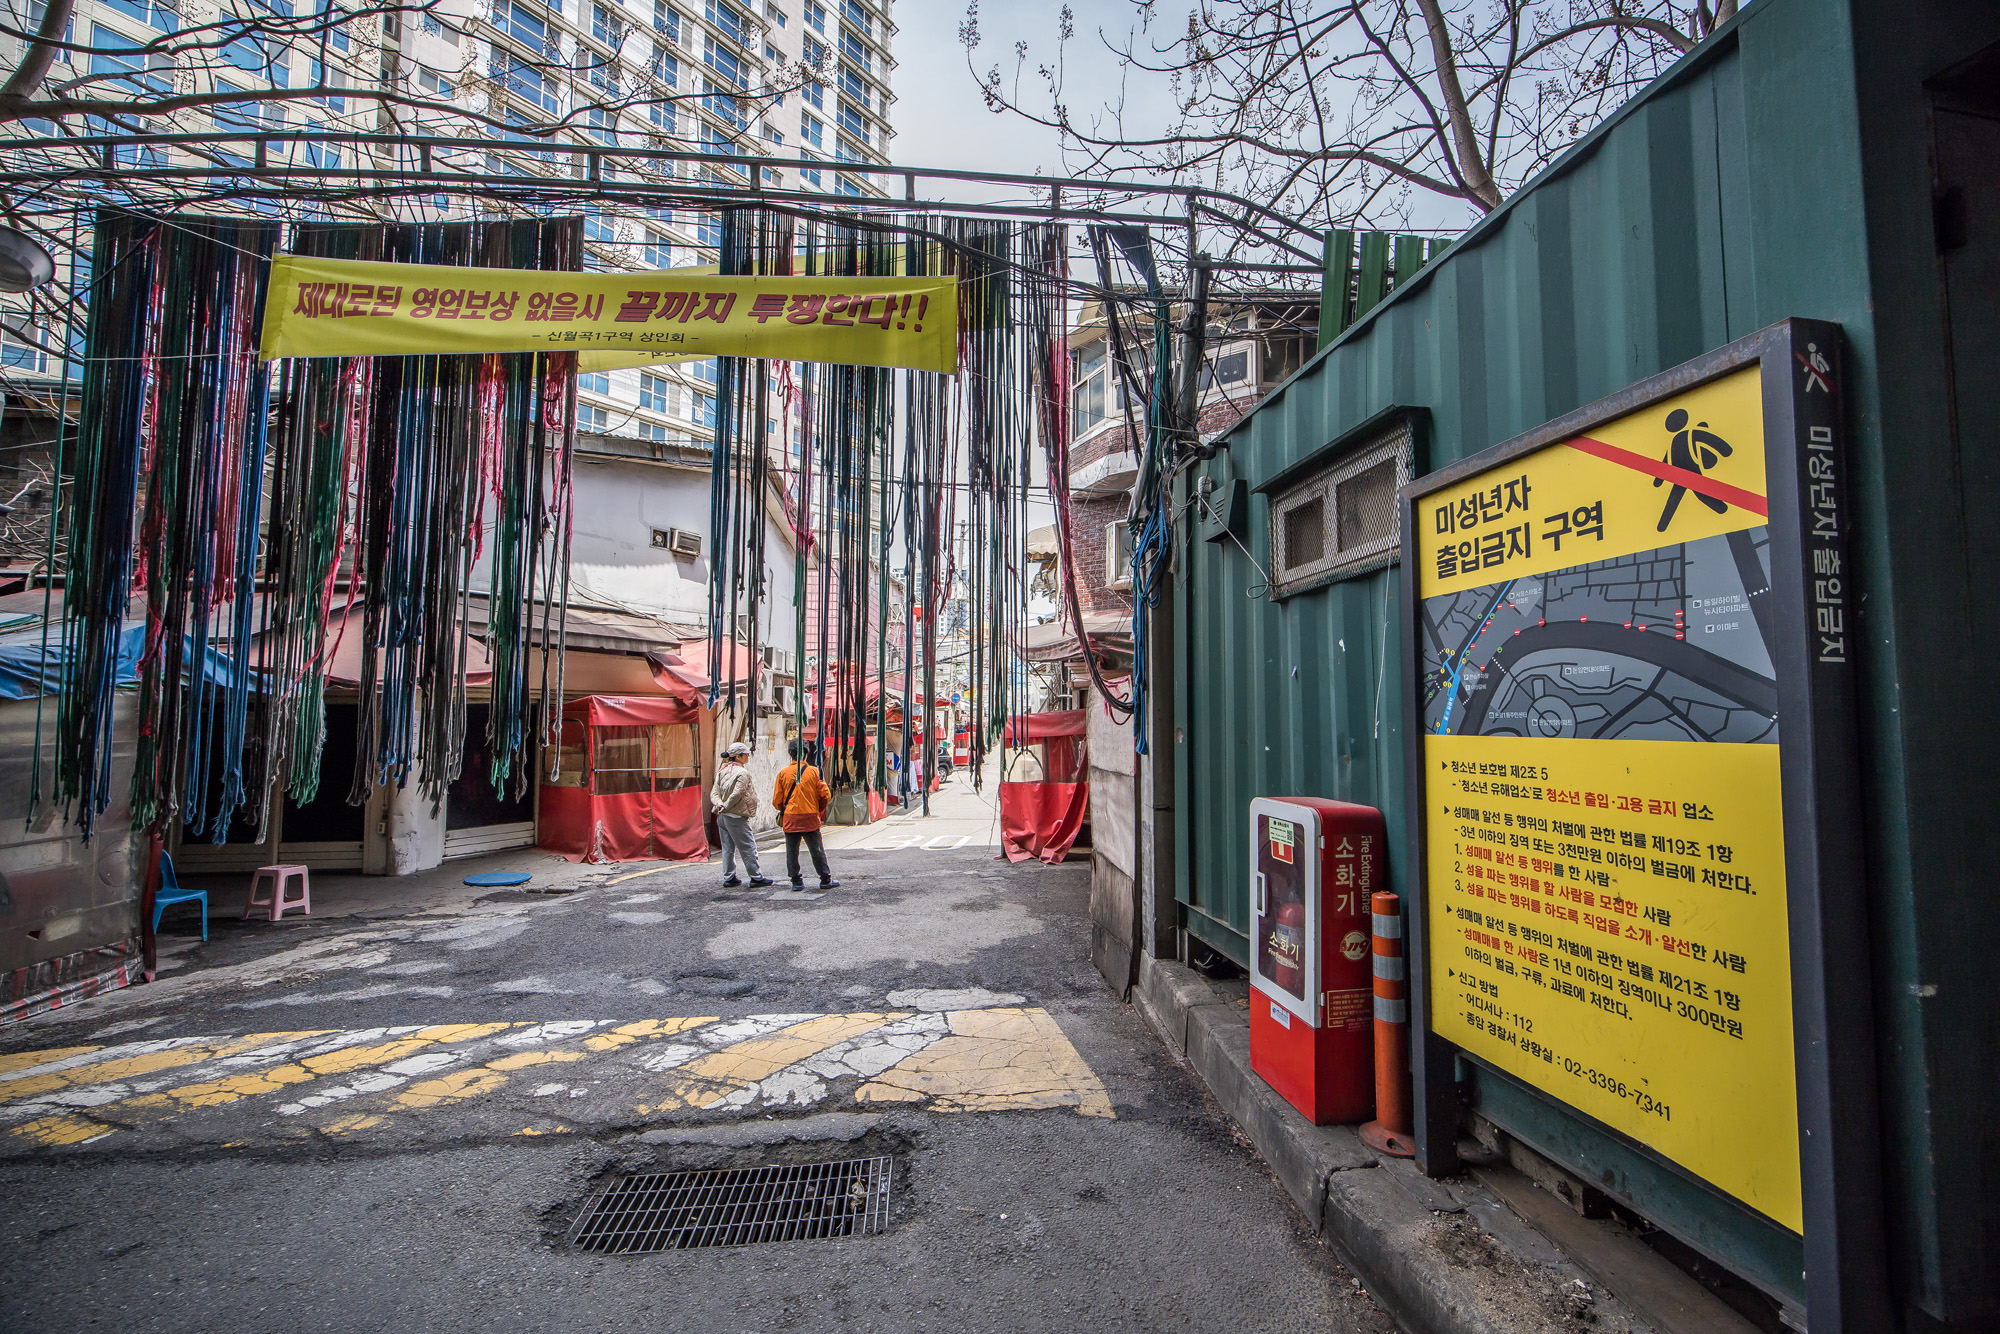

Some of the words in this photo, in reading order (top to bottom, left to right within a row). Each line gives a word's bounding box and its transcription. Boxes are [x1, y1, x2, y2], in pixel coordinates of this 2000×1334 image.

[293, 282, 403, 318] 제대로된
[410, 287, 520, 322] 영업보상
[524, 292, 605, 321] 없을시
[614, 290, 738, 324] 끝까지
[747, 293, 929, 333] 투쟁한다!!
[547, 331, 633, 343] 신월곡1구역
[639, 331, 685, 344] 상인회
[1435, 474, 1532, 535] 미성년자
[1807, 426, 1839, 540] 미성년자
[1437, 521, 1532, 580] 출입금지
[1542, 500, 1604, 552] 구역
[1703, 602, 1750, 616] 뉴시티아파트
[1716, 621, 1740, 631] 이마트
[1814, 548, 1846, 663] 출입금지
[1450, 760, 1477, 775] 청소년
[1479, 762, 1507, 778] 보호법
[1509, 764, 1538, 780] 제2조
[1540, 767, 1549, 781] 5
[1546, 787, 1581, 806] 청소년
[1647, 799, 1677, 818] 금지
[1682, 802, 1715, 821] 업소
[863, 835, 974, 852] 30
[1453, 806, 1480, 822] 성매매
[1482, 810, 1501, 825] 알선
[1503, 813, 1514, 827] 등
[1516, 814, 1548, 833] 행위의
[1551, 819, 1586, 839] 처벌에
[1589, 825, 1616, 844] 관한
[1619, 830, 1647, 849] 법률
[1651, 835, 1702, 858] 제19조
[1706, 844, 1733, 864] 1항
[1460, 825, 1476, 840] 3년
[1478, 828, 1506, 846] 이하의
[1509, 833, 1529, 850] 징역
[1532, 837, 1555, 855] 또는
[1557, 842, 1602, 864] 3천만원
[1606, 851, 1646, 873] 이하의
[1650, 858, 1696, 884] 벌금에
[1701, 868, 1757, 896] 처한다.
[1335, 836, 1356, 916] 소화기
[1454, 842, 1463, 855] 1.
[1465, 844, 1492, 862] 성매매
[1495, 850, 1515, 867] 알선
[1517, 855, 1529, 870] 등
[1530, 857, 1565, 878] 행위를
[1568, 865, 1581, 882] 한
[1584, 869, 1611, 888] 사람
[1454, 860, 1464, 874] 2.
[1465, 863, 1484, 879] 성을
[1486, 868, 1506, 885] 파는
[1508, 872, 1541, 893] 행위를
[1543, 880, 1555, 897] 할
[1558, 885, 1596, 907] 사람을
[1599, 894, 1639, 918] 모집한
[1642, 905, 1672, 927] 사람
[1269, 931, 1299, 962] 소화기
[1454, 878, 1464, 893] 3.
[1466, 882, 1485, 898] 성을
[1487, 887, 1507, 905] 파는
[1509, 892, 1542, 914] 행위를
[1544, 902, 1579, 925] 하도록
[1583, 912, 1621, 937] 직업을
[1712, 949, 1747, 975] 사람
[1455, 906, 1483, 926] 성매매
[1485, 915, 1505, 933] 알선
[1507, 922, 1518, 937] 등
[1520, 925, 1553, 949] 행위의
[1556, 937, 1593, 962] 처벌에
[1596, 949, 1624, 972] 관한
[1626, 958, 1654, 983] 법률
[1658, 969, 1709, 1001] 제21조
[1713, 989, 1741, 1012] 1항
[1458, 971, 1477, 989] 신고
[1479, 979, 1499, 999] 방법
[1463, 927, 1501, 951] 성매매를
[1503, 940, 1514, 956] 한
[1517, 945, 1550, 968] 사람은
[1552, 957, 1572, 976] 1년
[1575, 965, 1613, 991] 이하의
[1617, 978, 1673, 1013] 징역이나
[1676, 1000, 1744, 1041] 300만원
[1464, 946, 1492, 967] 이하의
[1494, 956, 1518, 978] 벌금,
[1520, 966, 1547, 989] 구류,
[1550, 976, 1586, 1003] 과료에
[1589, 991, 1633, 1021] 처한다.
[1465, 992, 1504, 1020] 어디서나
[1512, 1013, 1533, 1034] 112
[1466, 1011, 1485, 1031] 종암
[1487, 1020, 1516, 1047] 경찰서
[1519, 1036, 1553, 1064] 상황실
[1564, 1058, 1670, 1122] 02-3396-7341
